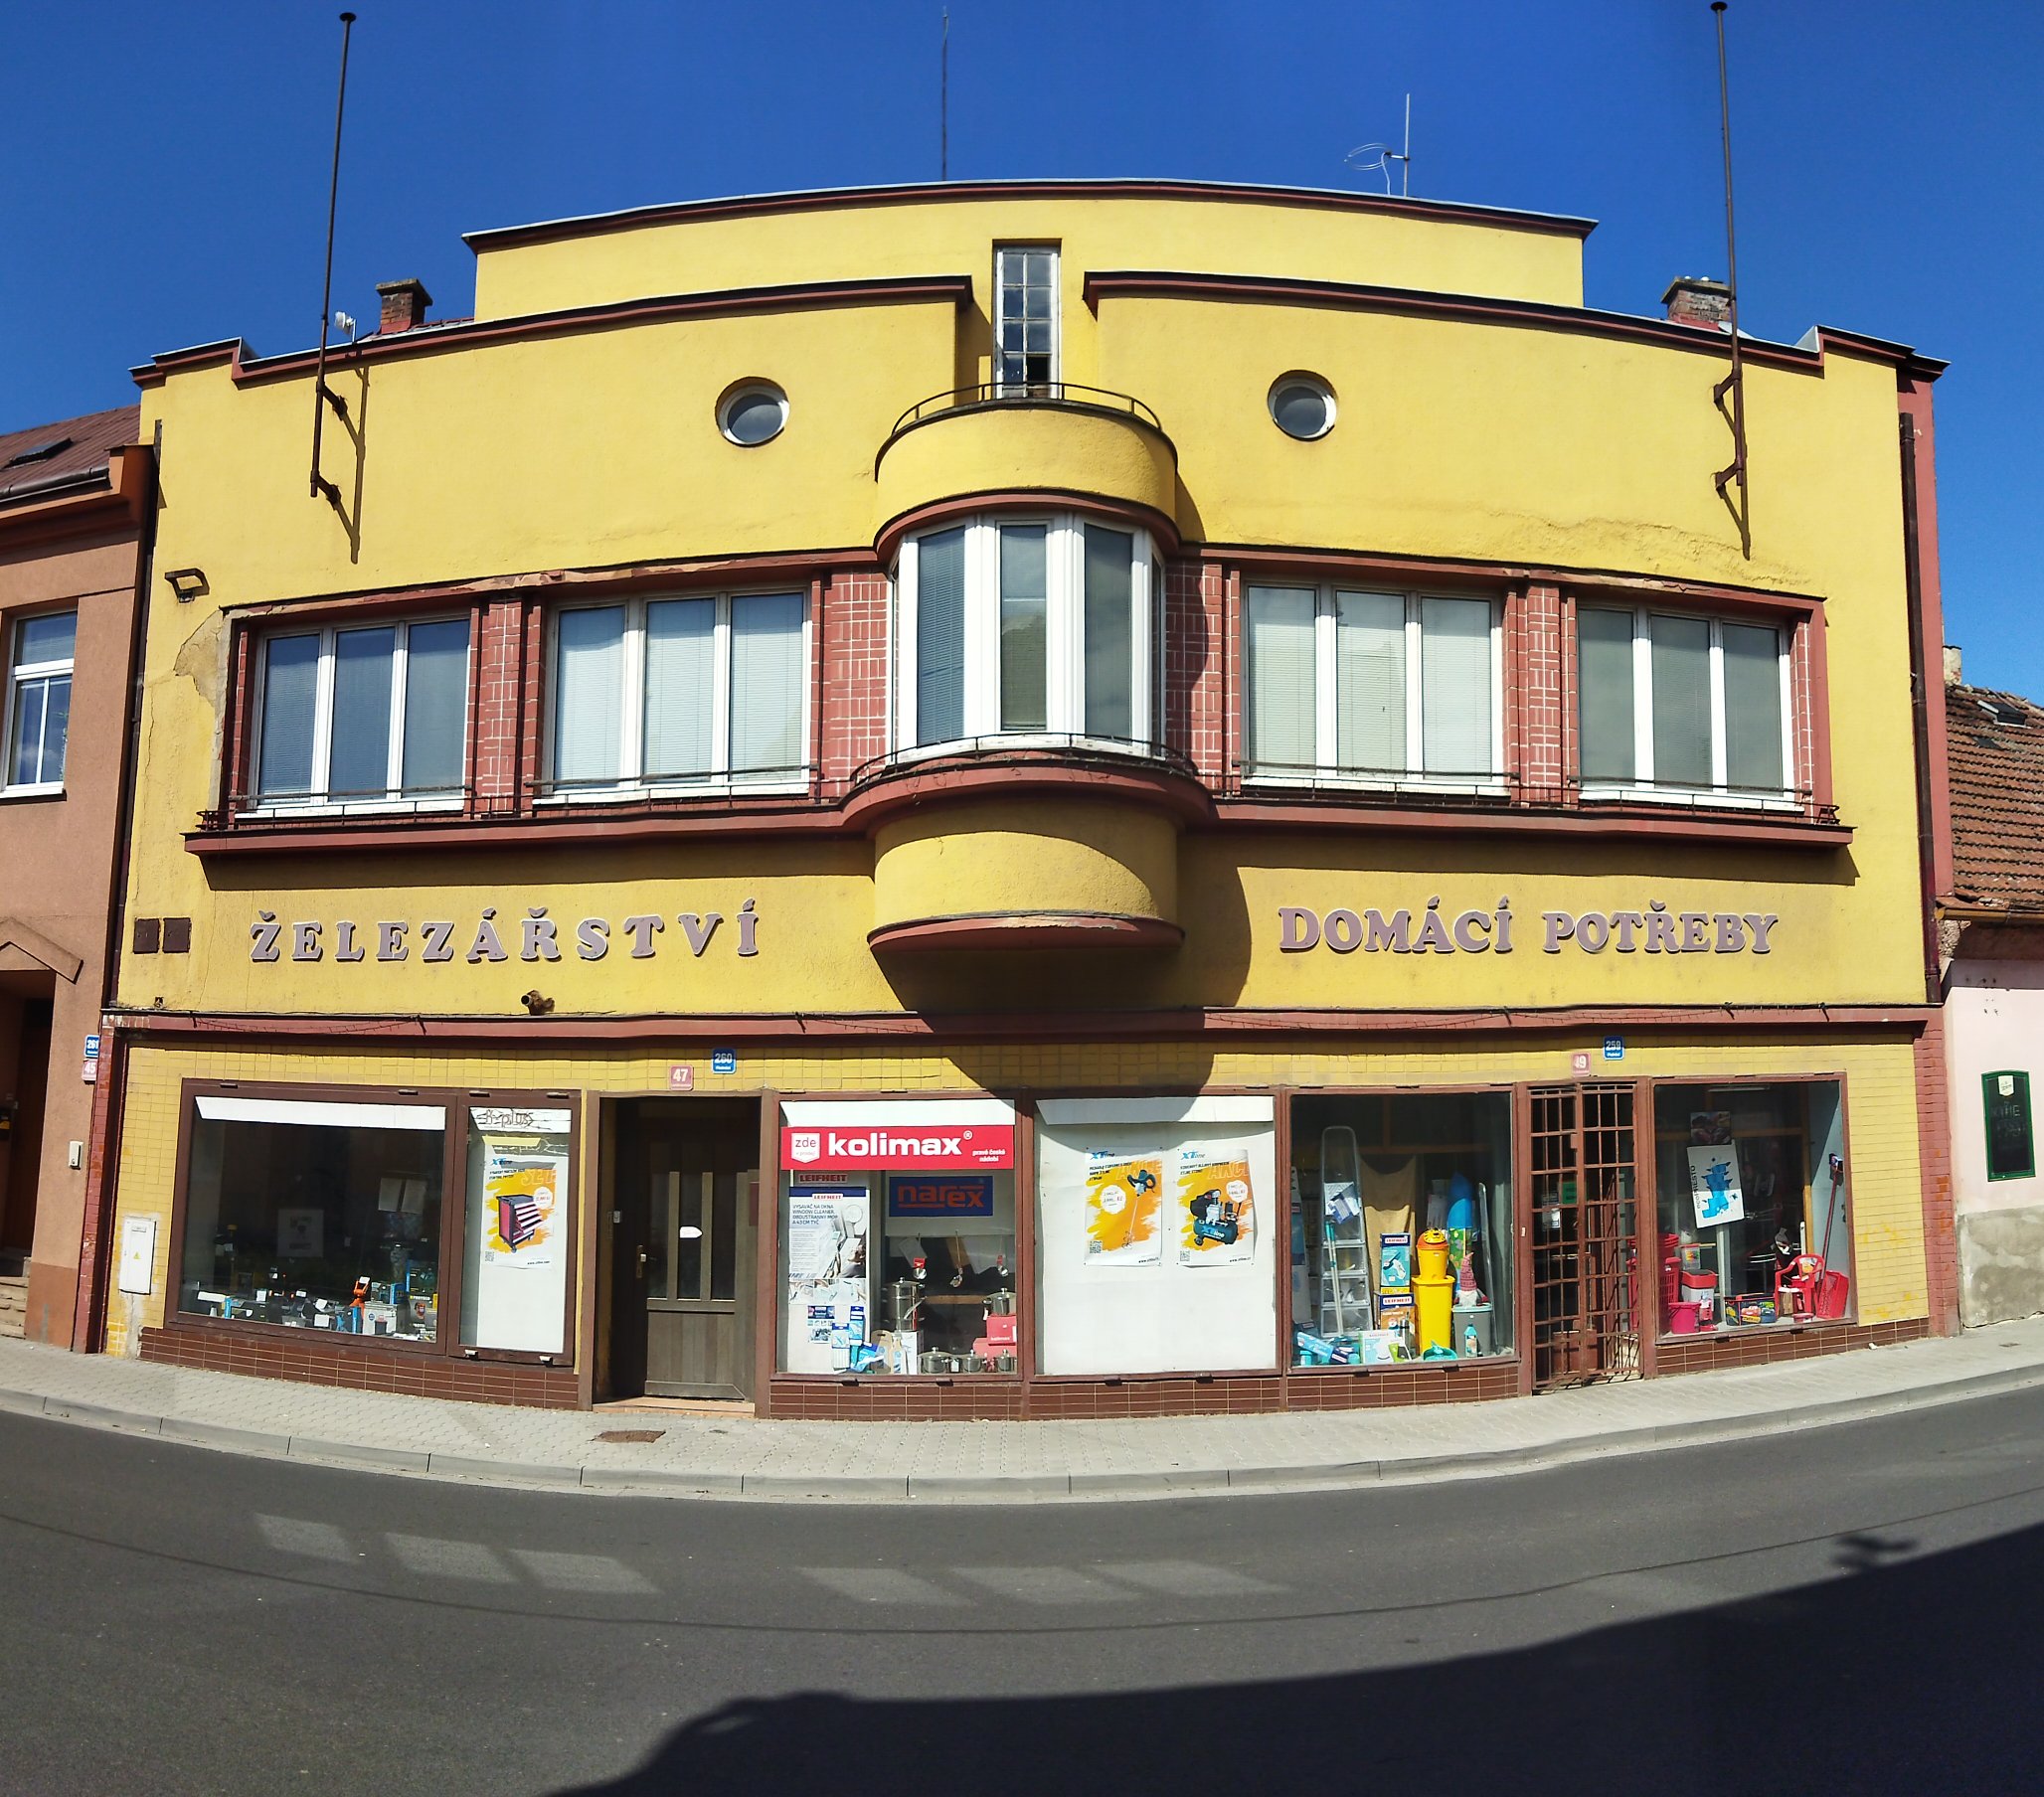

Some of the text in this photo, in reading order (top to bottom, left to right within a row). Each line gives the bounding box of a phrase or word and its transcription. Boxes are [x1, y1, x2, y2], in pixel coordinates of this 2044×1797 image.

[250, 898, 759, 961] ŽELEZÁŘSTVÍ
[1278, 896, 1779, 953] DOMÁCÍ POTŘEBY
[86, 1040, 98, 1050] 261
[1606, 1041, 1621, 1051] 259
[715, 1054, 733, 1063] 260
[85, 1062, 96, 1073] 45
[673, 1068, 689, 1081] 47
[795, 1137, 816, 1148] zde
[898, 1185, 985, 1209] narex
